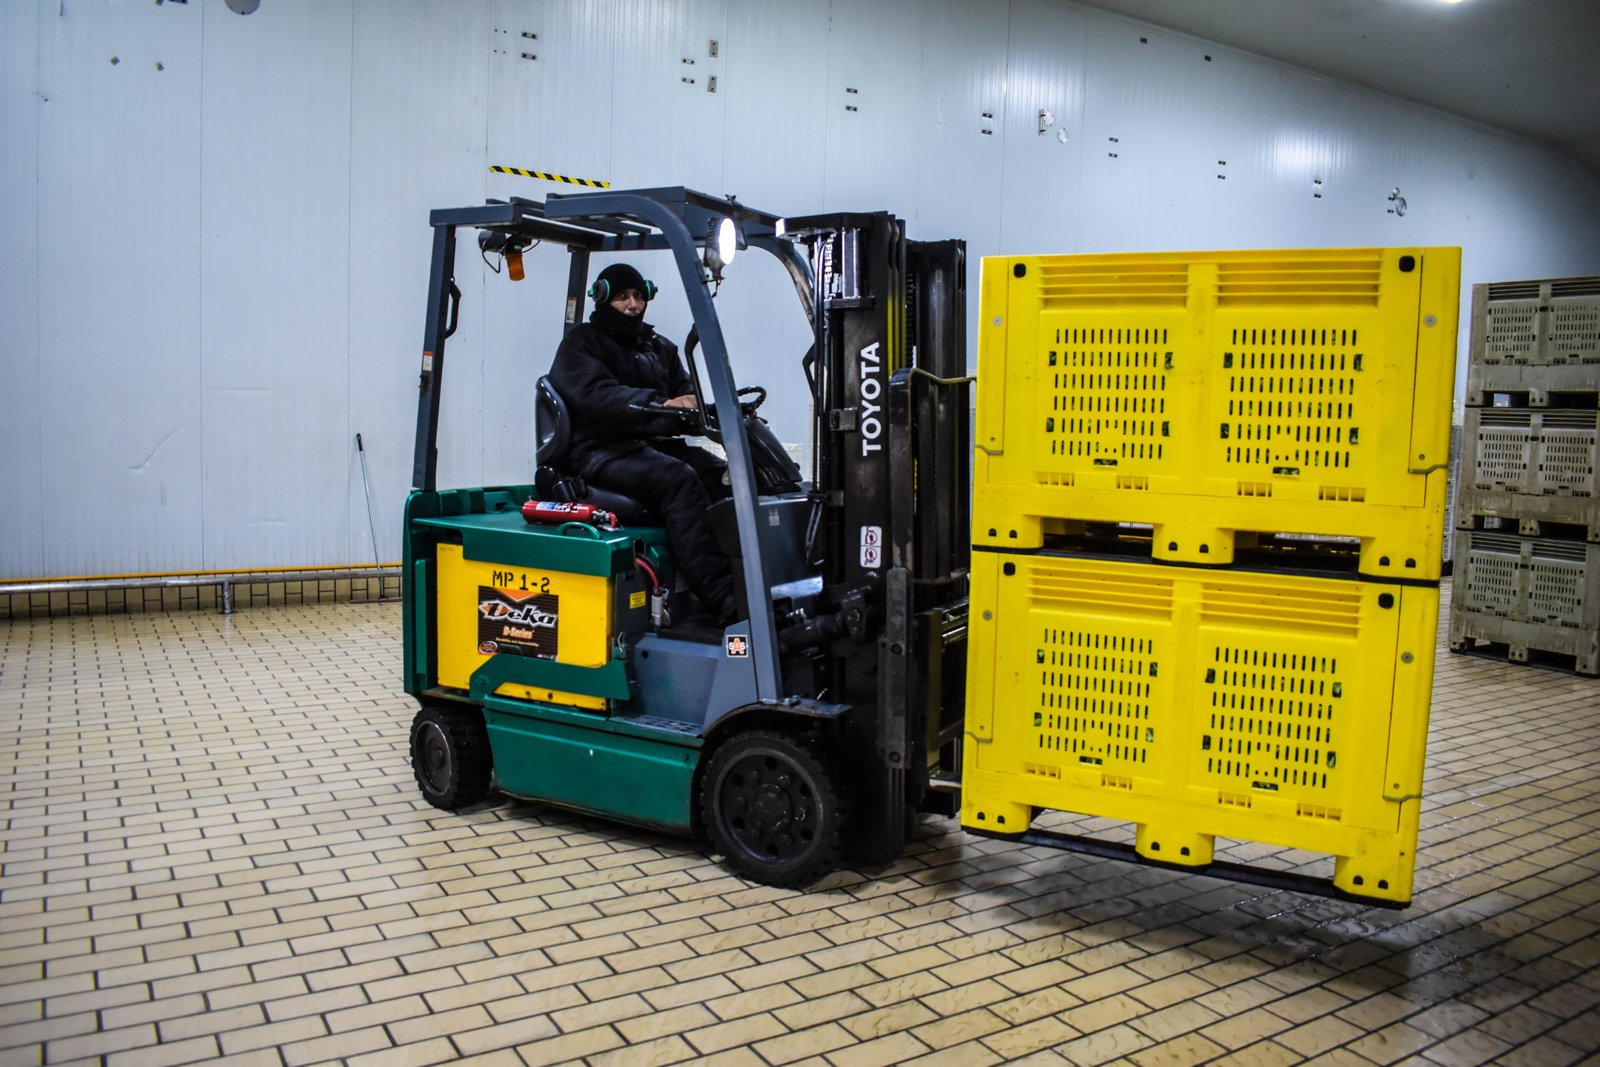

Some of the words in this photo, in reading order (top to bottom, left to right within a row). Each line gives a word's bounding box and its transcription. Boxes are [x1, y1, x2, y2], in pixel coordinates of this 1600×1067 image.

[860, 341, 882, 457] TOYOTA
[492, 570, 514, 587] MP
[519, 573, 550, 594] 1-2
[478, 600, 557, 627] Deka
[502, 626, 532, 639] D-Series
